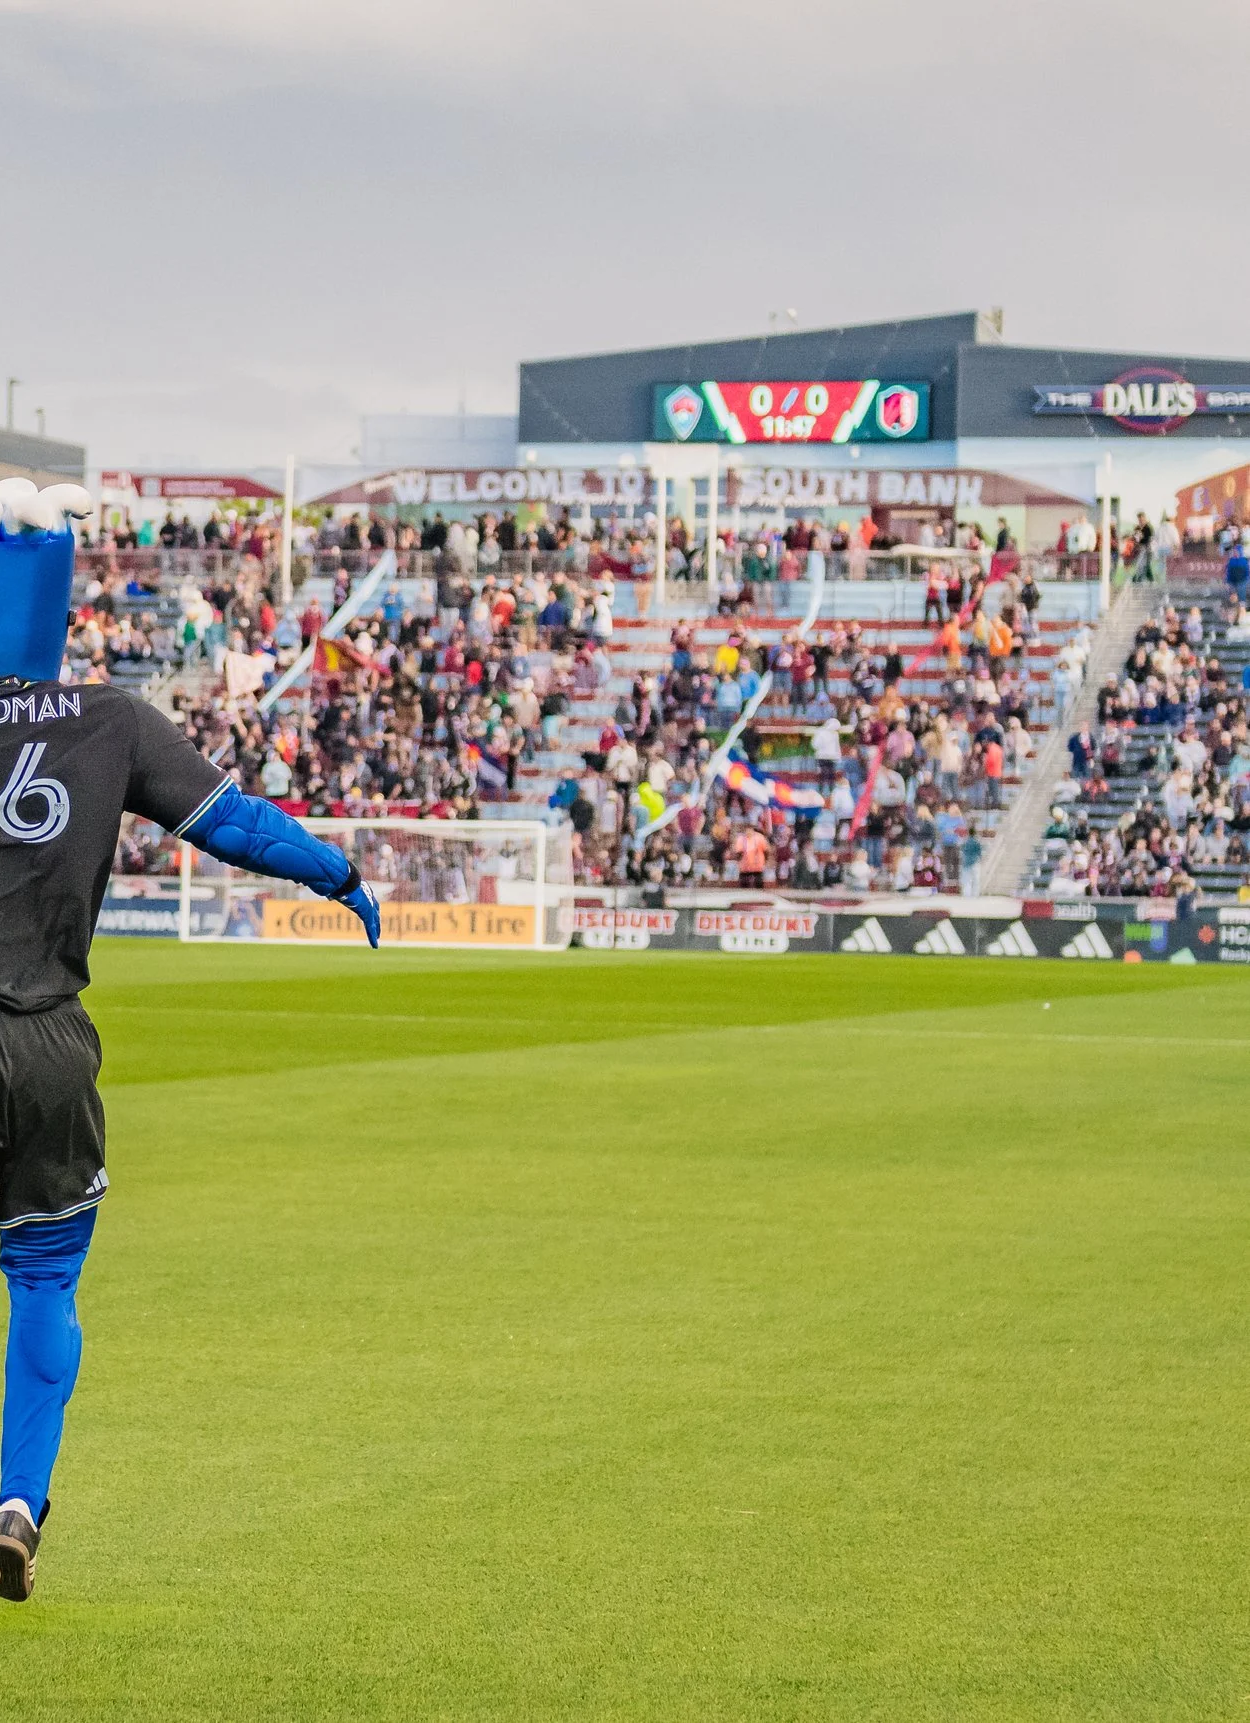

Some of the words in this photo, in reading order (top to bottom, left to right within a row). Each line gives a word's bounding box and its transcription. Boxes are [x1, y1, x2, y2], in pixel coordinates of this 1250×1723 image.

[750, 385, 773, 416] 0
[805, 385, 829, 415] 0
[1047, 391, 1093, 408] THE
[393, 470, 585, 504] WELCOME
[600, 468, 646, 502] TO
[736, 467, 869, 502] SOUTH
[877, 471, 983, 505] BANK
[465, 909, 526, 936] Tire
[699, 912, 813, 935] DISCOUNT
